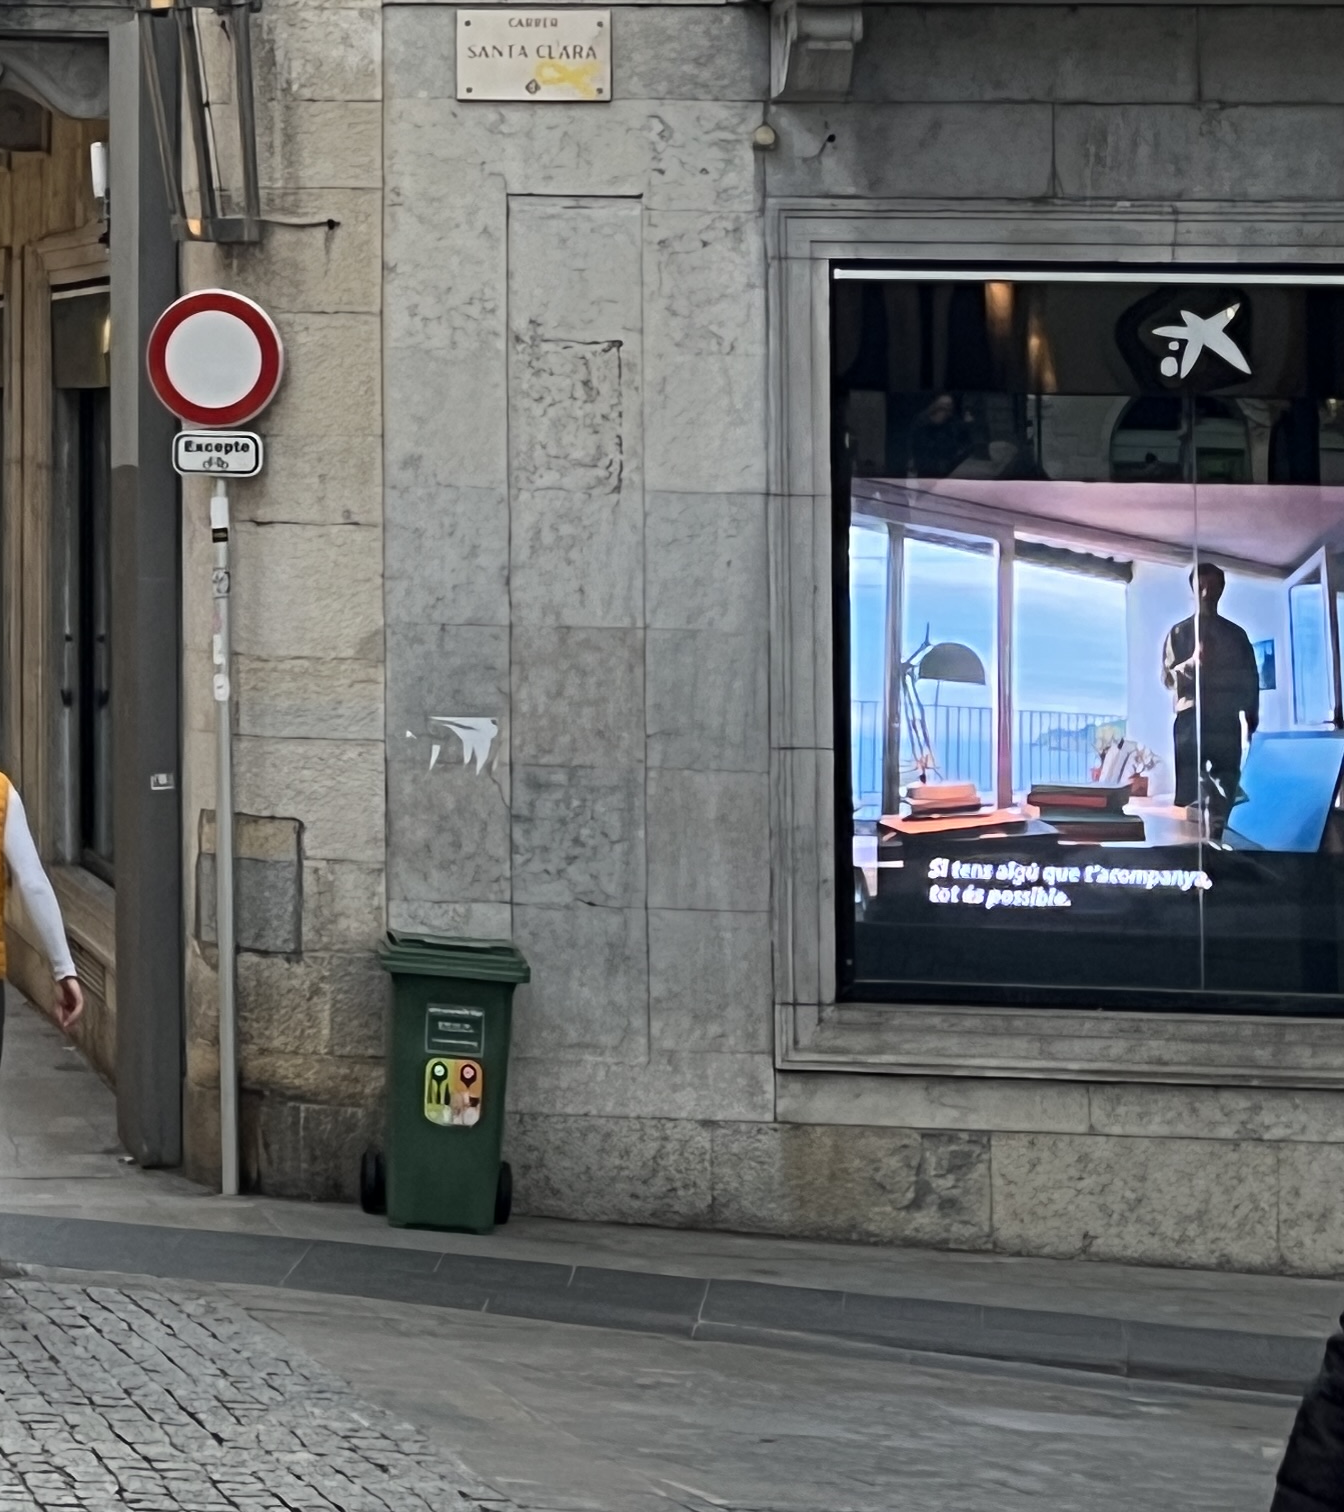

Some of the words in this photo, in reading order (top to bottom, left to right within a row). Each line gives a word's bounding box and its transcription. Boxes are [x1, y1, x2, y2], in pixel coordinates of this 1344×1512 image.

[508, 17, 558, 28] CARRER
[467, 44, 528, 59] SANTA
[536, 44, 597, 60] CLARA
[184, 440, 250, 455] Excepte
[1042, 866, 1081, 886] que
[929, 884, 960, 904] tot
